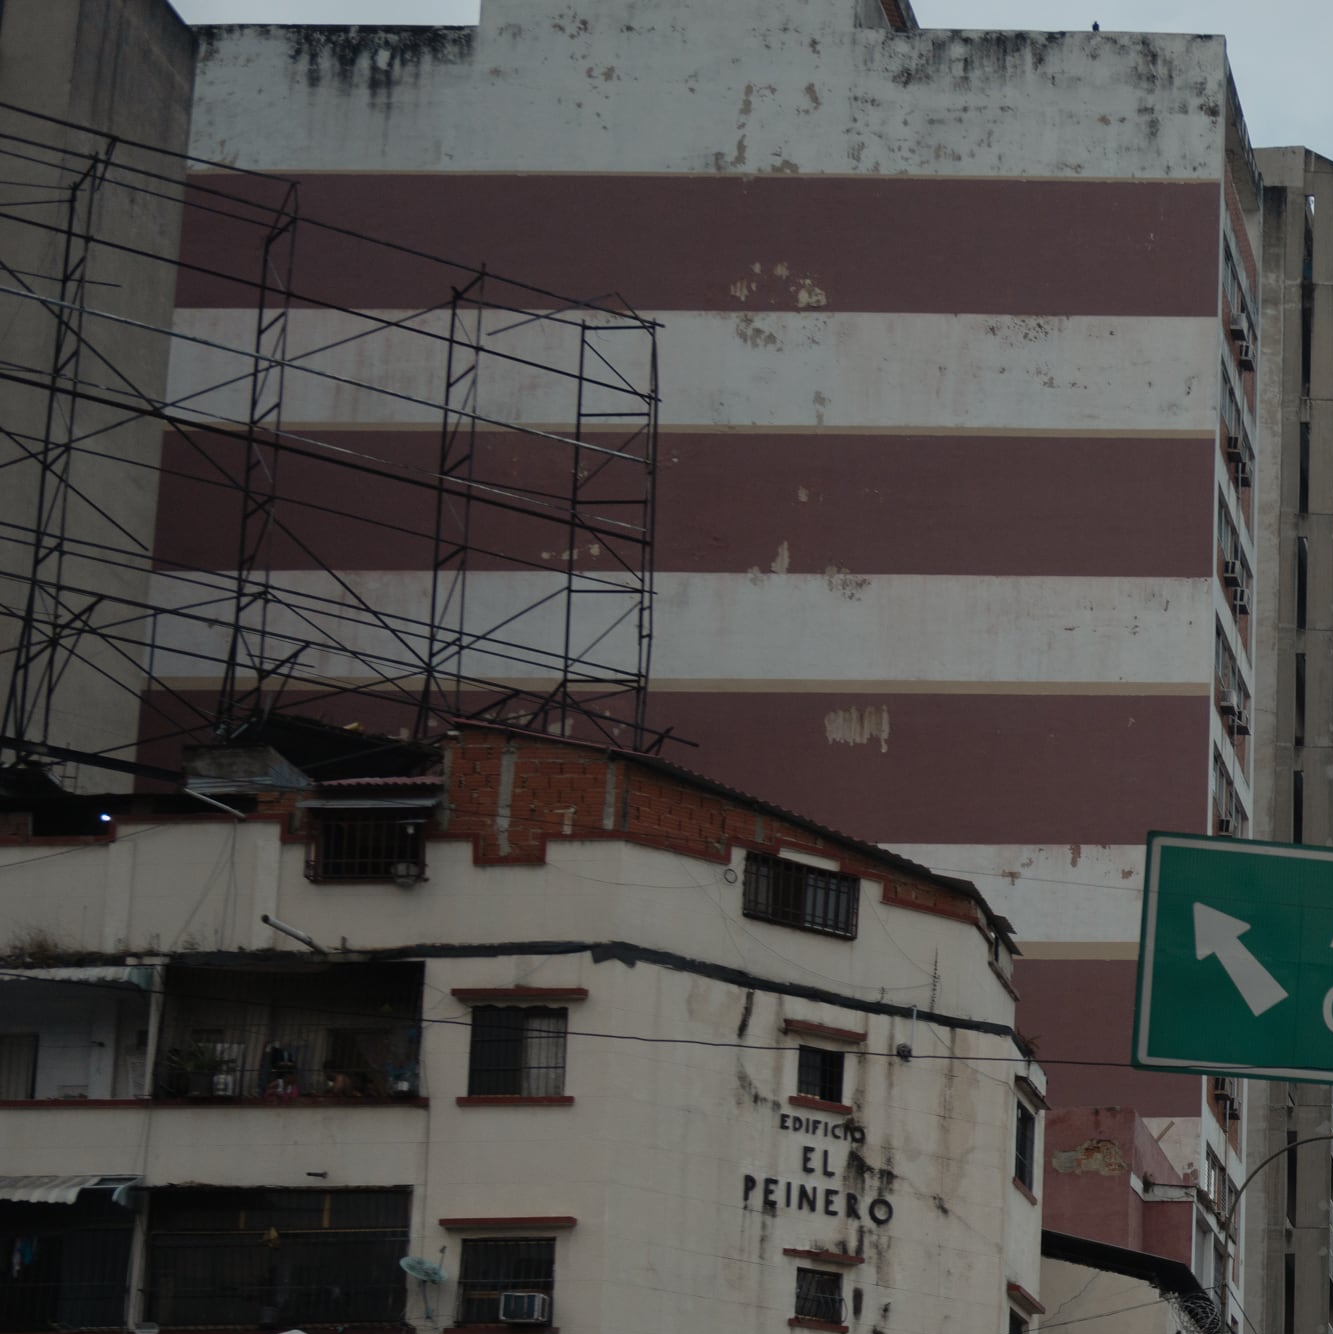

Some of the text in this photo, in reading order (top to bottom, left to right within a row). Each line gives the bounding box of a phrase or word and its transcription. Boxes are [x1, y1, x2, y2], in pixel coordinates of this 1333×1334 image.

[780, 1113, 865, 1144] EDIFICIO
[803, 1146, 835, 1177] EL
[744, 1175, 893, 1225] PEINERO
